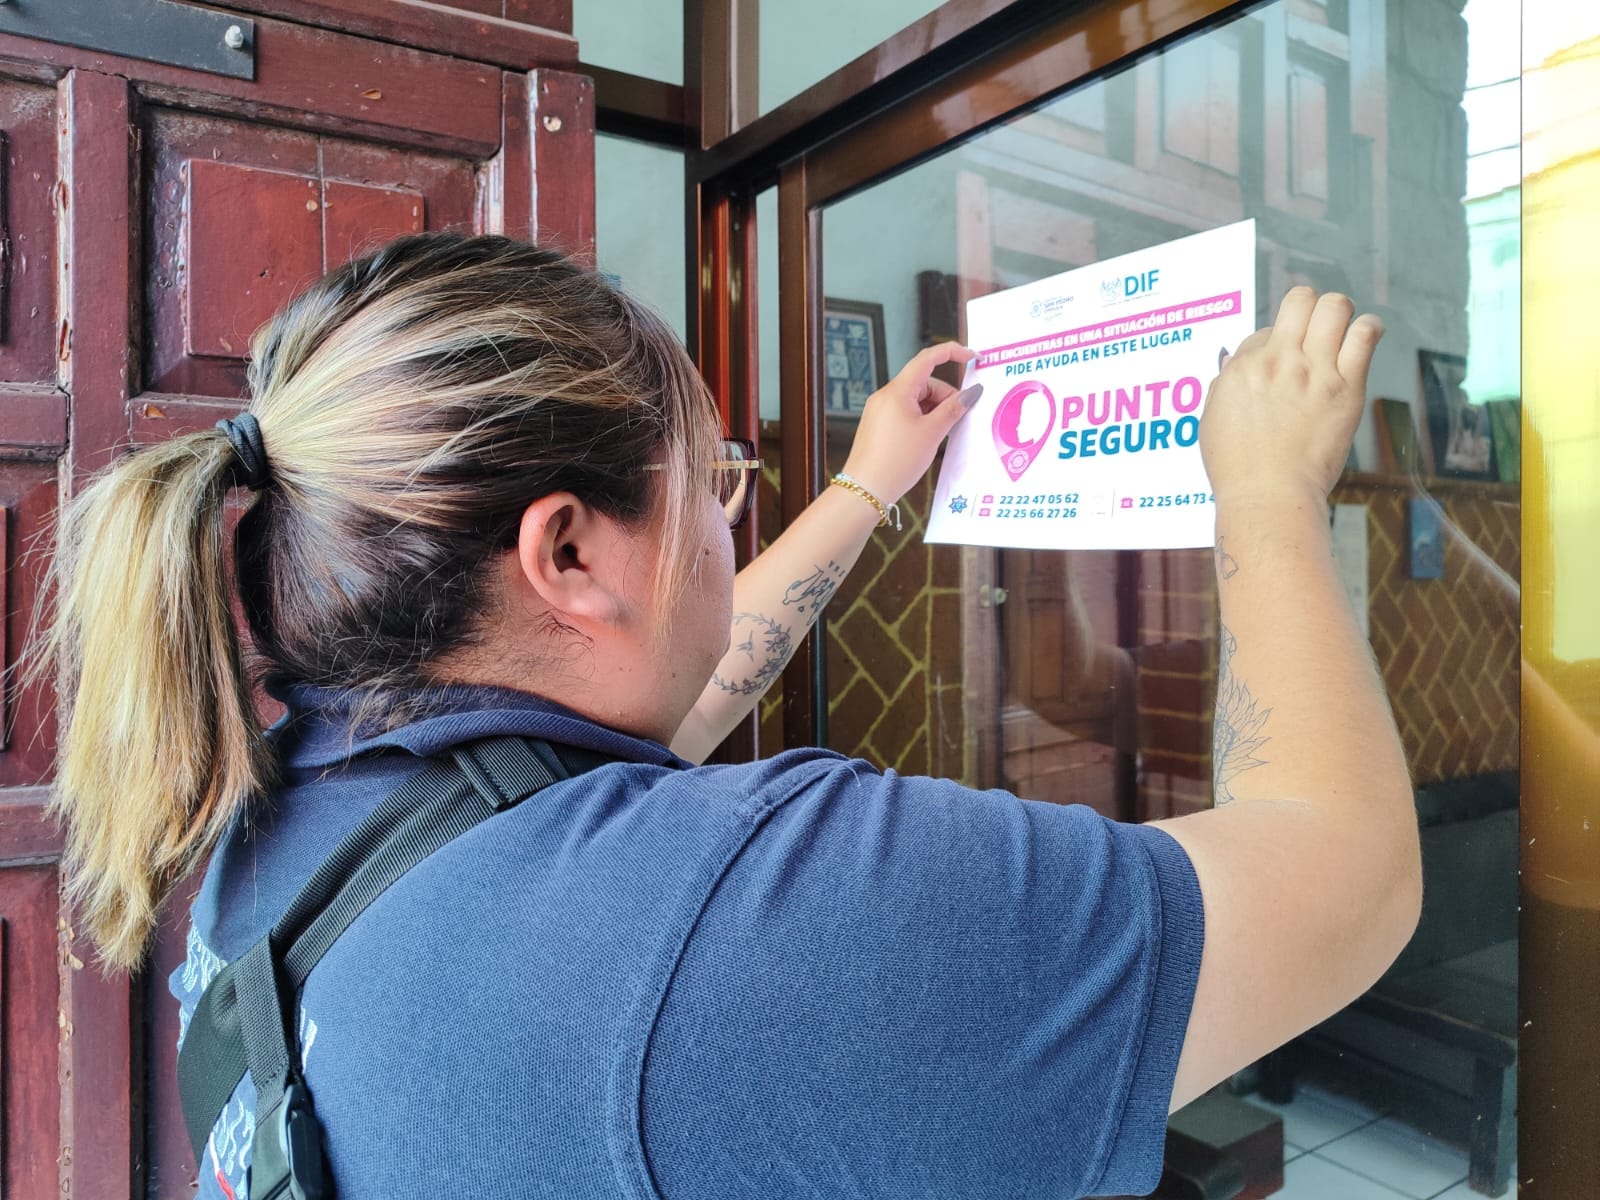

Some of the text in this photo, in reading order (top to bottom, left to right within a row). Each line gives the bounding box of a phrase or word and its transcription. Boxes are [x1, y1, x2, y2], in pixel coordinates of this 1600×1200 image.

[1124, 269, 1159, 297] DIF
[989, 351, 1000, 363] TE
[1000, 337, 1064, 361] ENCUENTRAS
[1063, 333, 1078, 347] EN
[1079, 328, 1102, 345] UNA
[1103, 313, 1166, 338] SITUACIÓN
[1166, 309, 1184, 324] DE
[1185, 299, 1234, 320] RIESGO
[1006, 327, 1193, 377] PIDE AYUDA EN ESTE LUGAR
[1061, 376, 1202, 429] PUNTO
[1058, 415, 1200, 459] SEGURO
[996, 508, 1011, 518] 22
[1013, 508, 1027, 518] 25
[1029, 508, 1044, 518] 66
[1046, 508, 1060, 518] 27
[1062, 507, 1077, 518] 26
[999, 493, 1079, 505] 22 22 47 05 62
[1139, 496, 1154, 507] 22
[1157, 495, 1172, 507] 25
[1174, 494, 1190, 506] 64
[1193, 493, 1206, 504] 73
